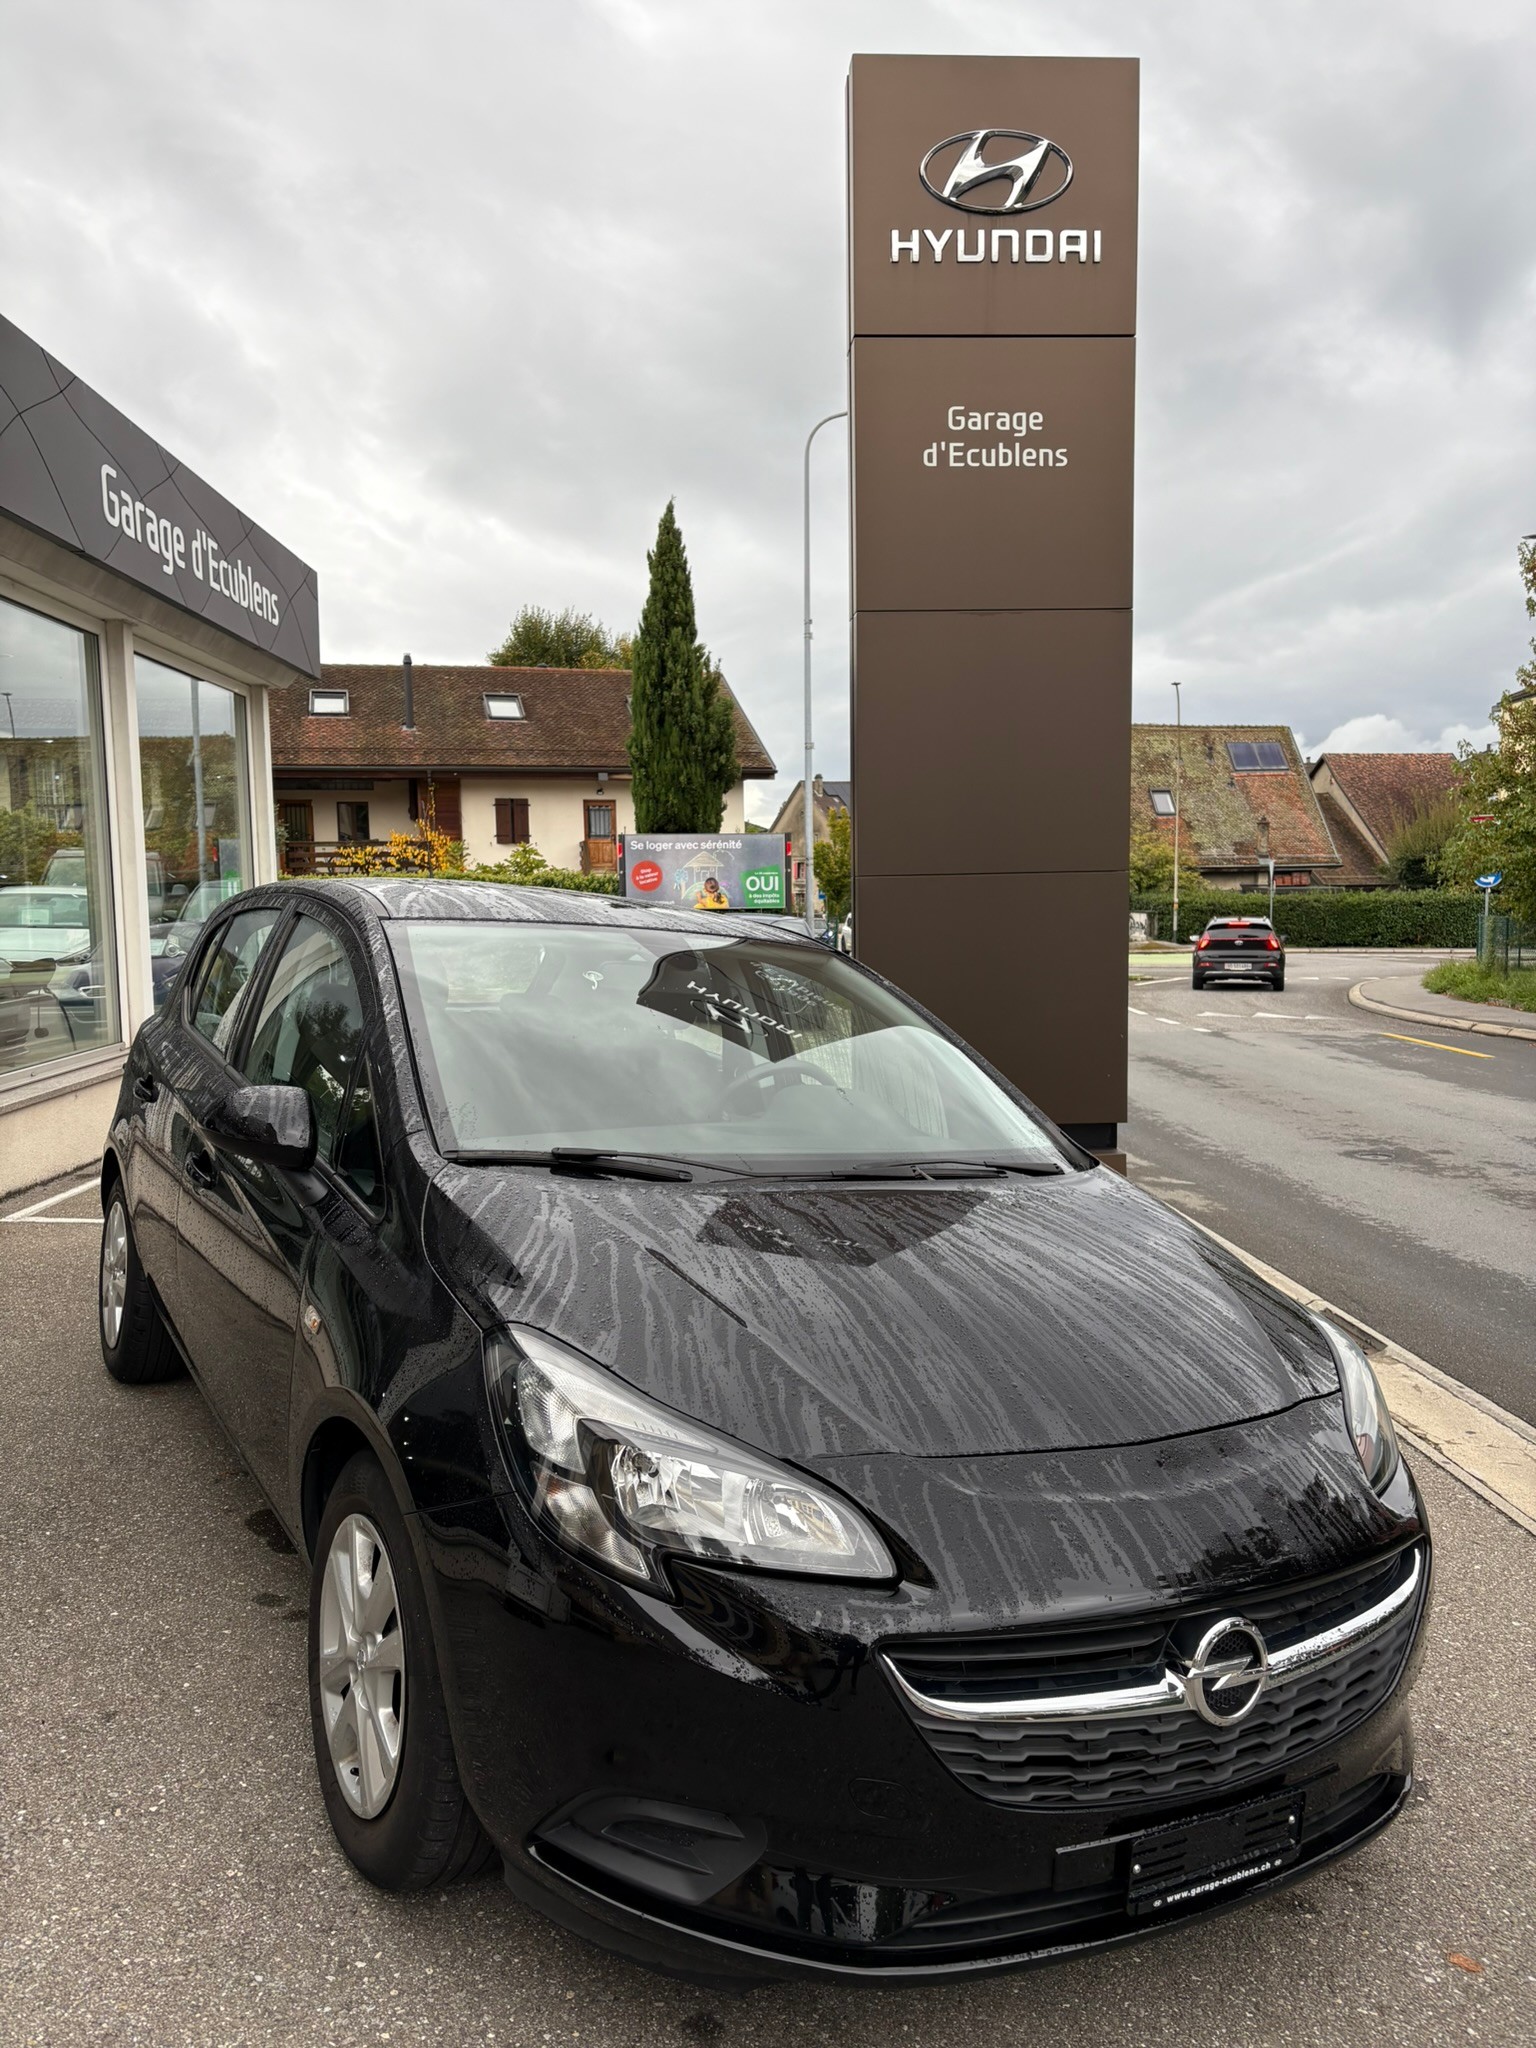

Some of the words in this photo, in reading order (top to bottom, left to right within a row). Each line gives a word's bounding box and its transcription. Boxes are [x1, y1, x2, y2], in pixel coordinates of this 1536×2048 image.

[890, 228, 1102, 264] HYUNDAI
[947, 405, 1044, 437] Garage
[922, 442, 1068, 467] d'Ecublens
[101, 463, 186, 576] Garage
[191, 528, 279, 627] d'Ecublens
[630, 840, 644, 850] Se
[646, 840, 672, 852] loger
[674, 841, 699, 850] avec
[700, 839, 742, 850] sérénité
[745, 875, 779, 892] OUI
[1166, 1861, 1271, 1903] www.garage-ecublens.ch
